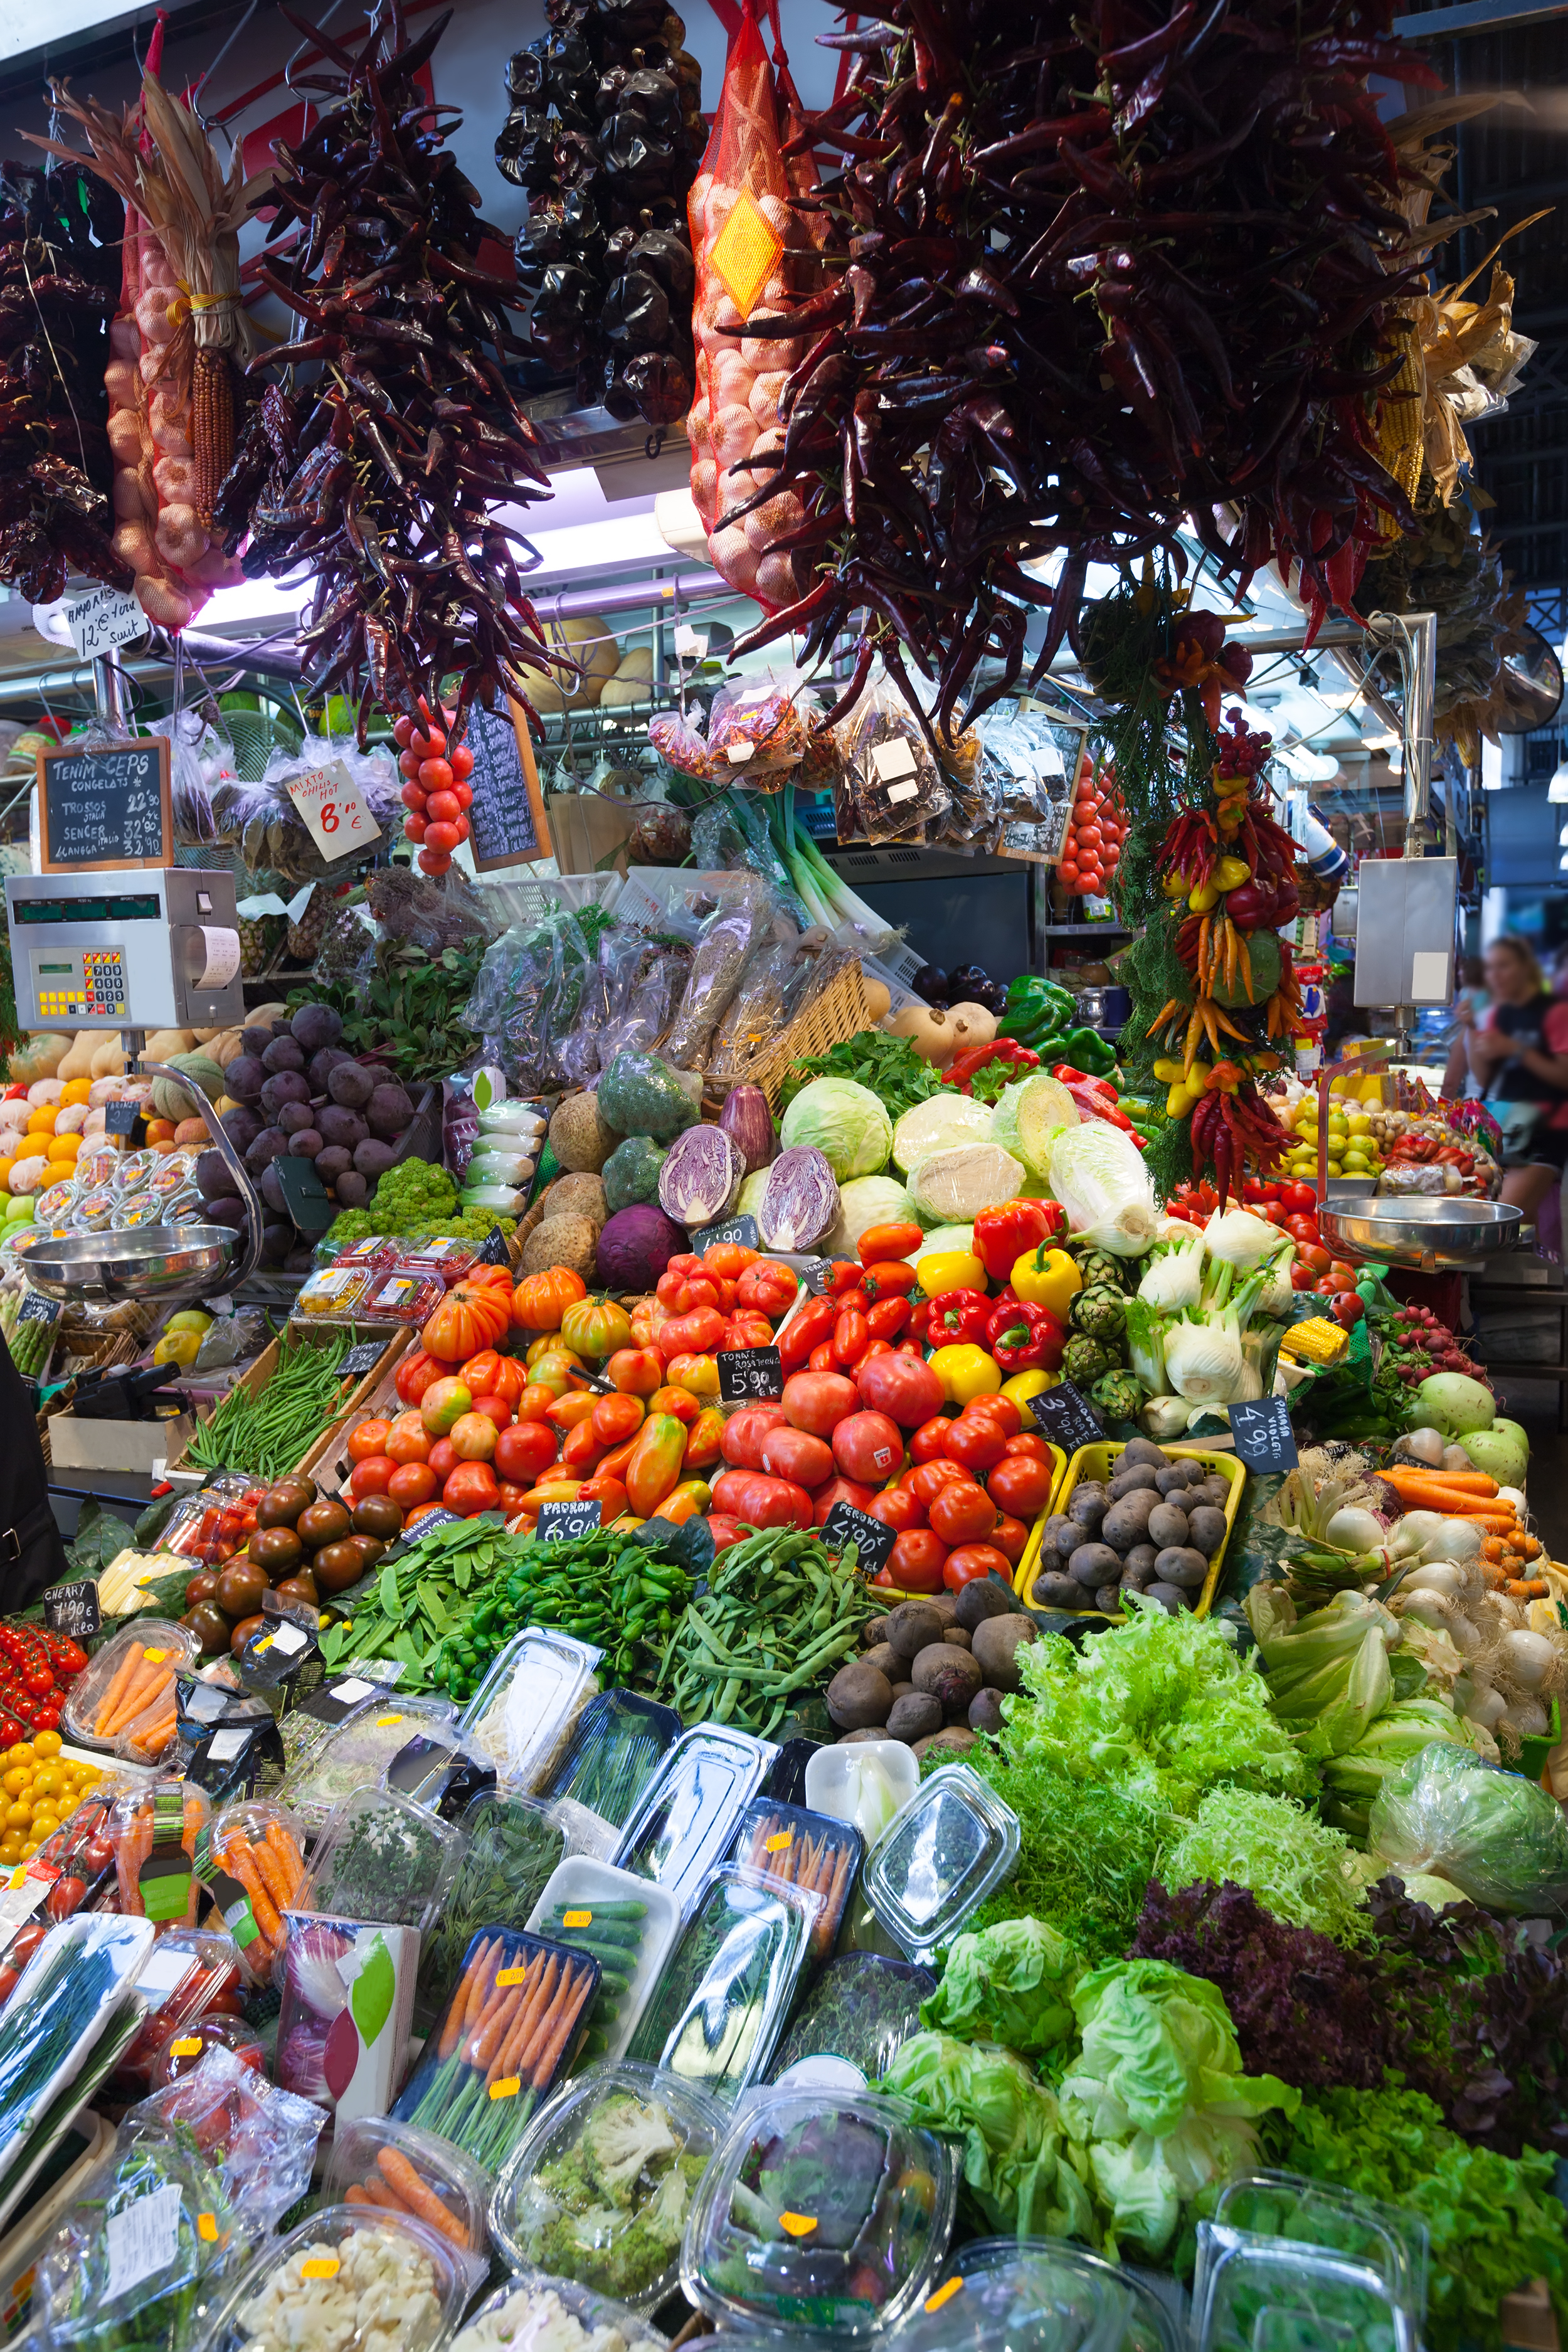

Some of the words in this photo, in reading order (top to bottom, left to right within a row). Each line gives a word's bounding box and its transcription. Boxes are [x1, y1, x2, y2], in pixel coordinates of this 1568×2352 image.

[105, 754, 149, 776] CEPS
[72, 777, 128, 792] CONGELATS
[320, 783, 339, 800] HOT
[62, 800, 106, 815] TROSSOS
[64, 825, 105, 840] SENCER
[731, 1370, 770, 1394] 5'90
[543, 1501, 594, 1516] PADRON
[839, 1503, 881, 1530] PERONA
[45, 1582, 86, 1601] CHERRY
[53, 1600, 85, 1626] 7'90
[511, 1971, 524, 1980] 2.90
